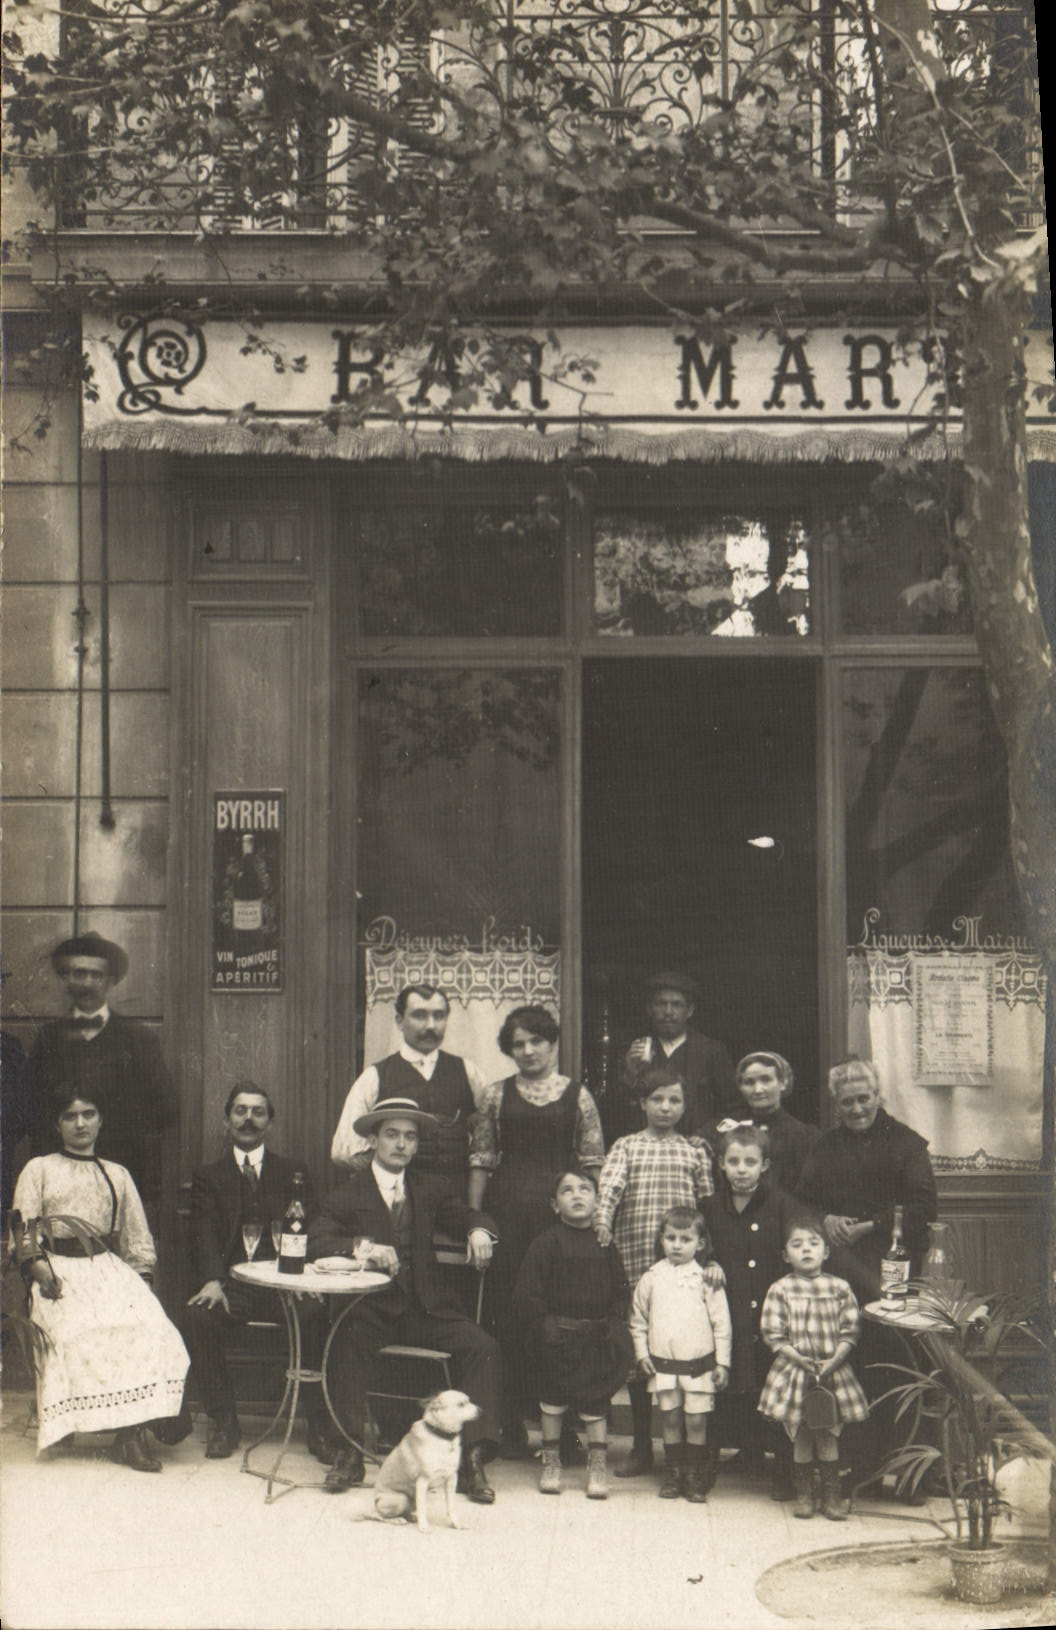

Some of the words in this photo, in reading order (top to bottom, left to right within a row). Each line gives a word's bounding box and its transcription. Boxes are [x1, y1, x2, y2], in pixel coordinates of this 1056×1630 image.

[331, 329, 550, 411] BAR
[216, 800, 280, 830] BYRRH
[857, 907, 933, 955] Liqueurs
[951, 912, 1035, 954] Marqu
[216, 951, 235, 964] VIN
[235, 949, 279, 969] TONIQUE
